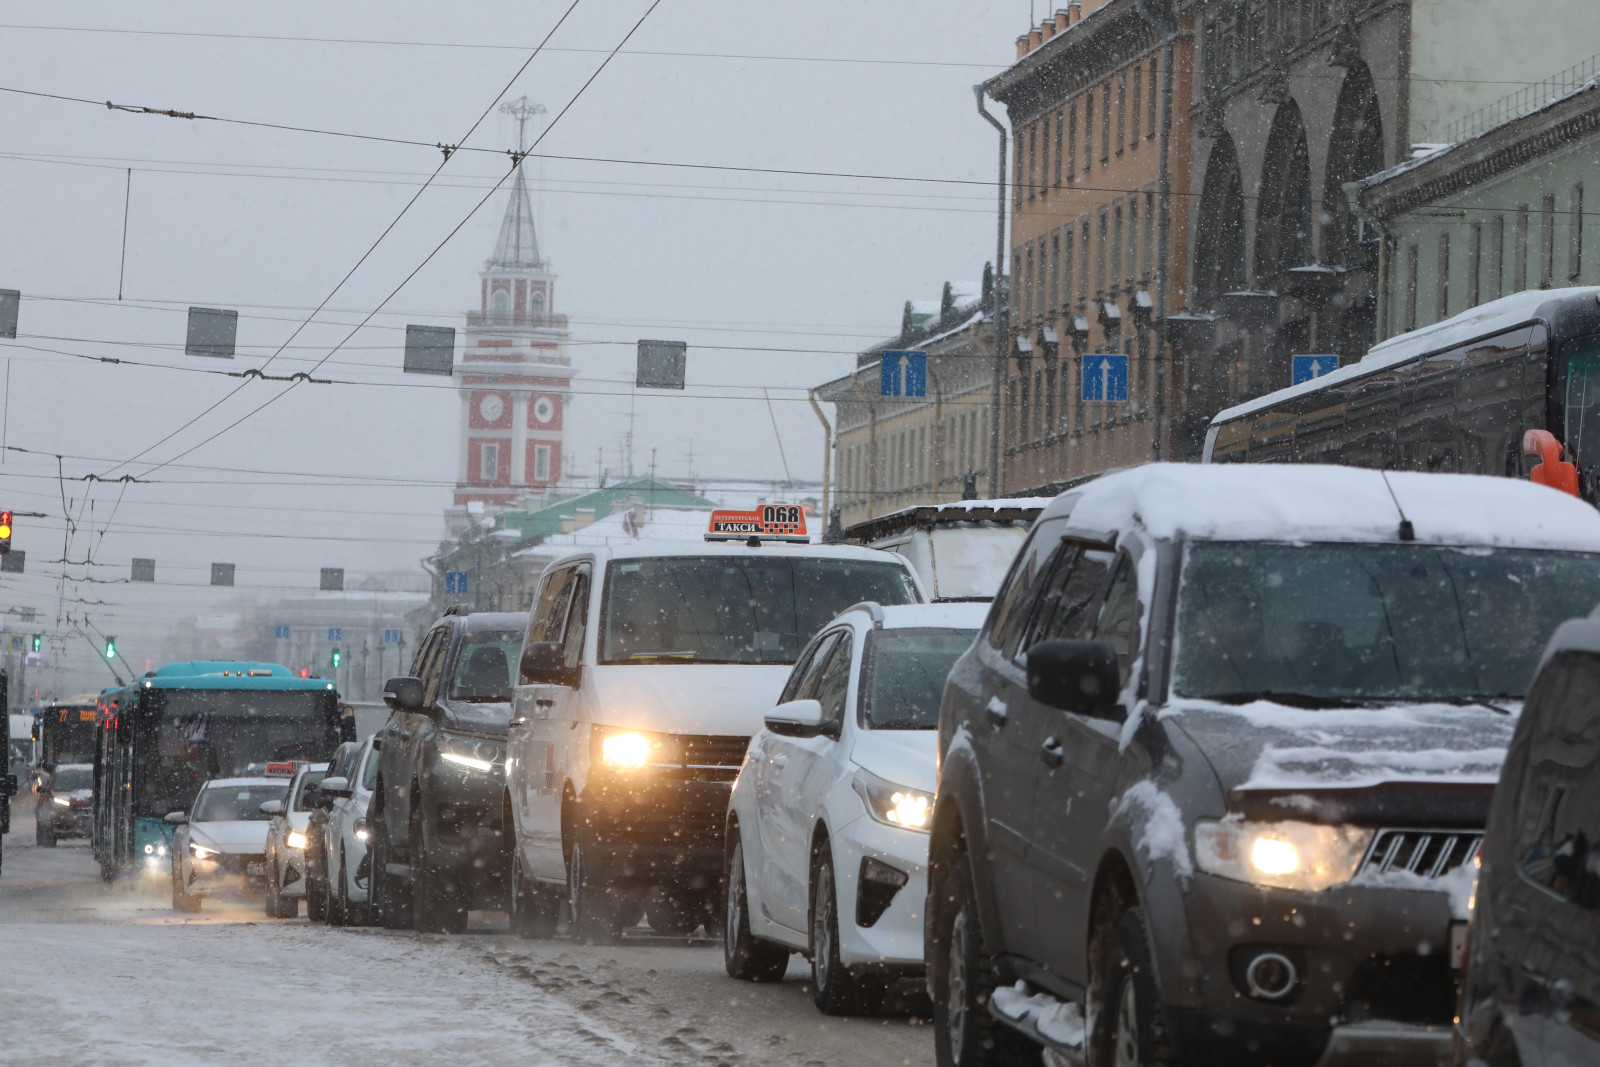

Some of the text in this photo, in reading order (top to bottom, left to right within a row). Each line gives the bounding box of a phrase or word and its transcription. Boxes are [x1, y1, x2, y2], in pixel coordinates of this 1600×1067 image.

[764, 506, 799, 523] 068
[718, 523, 756, 532] ТАКСИ
[59, 708, 68, 722] 27
